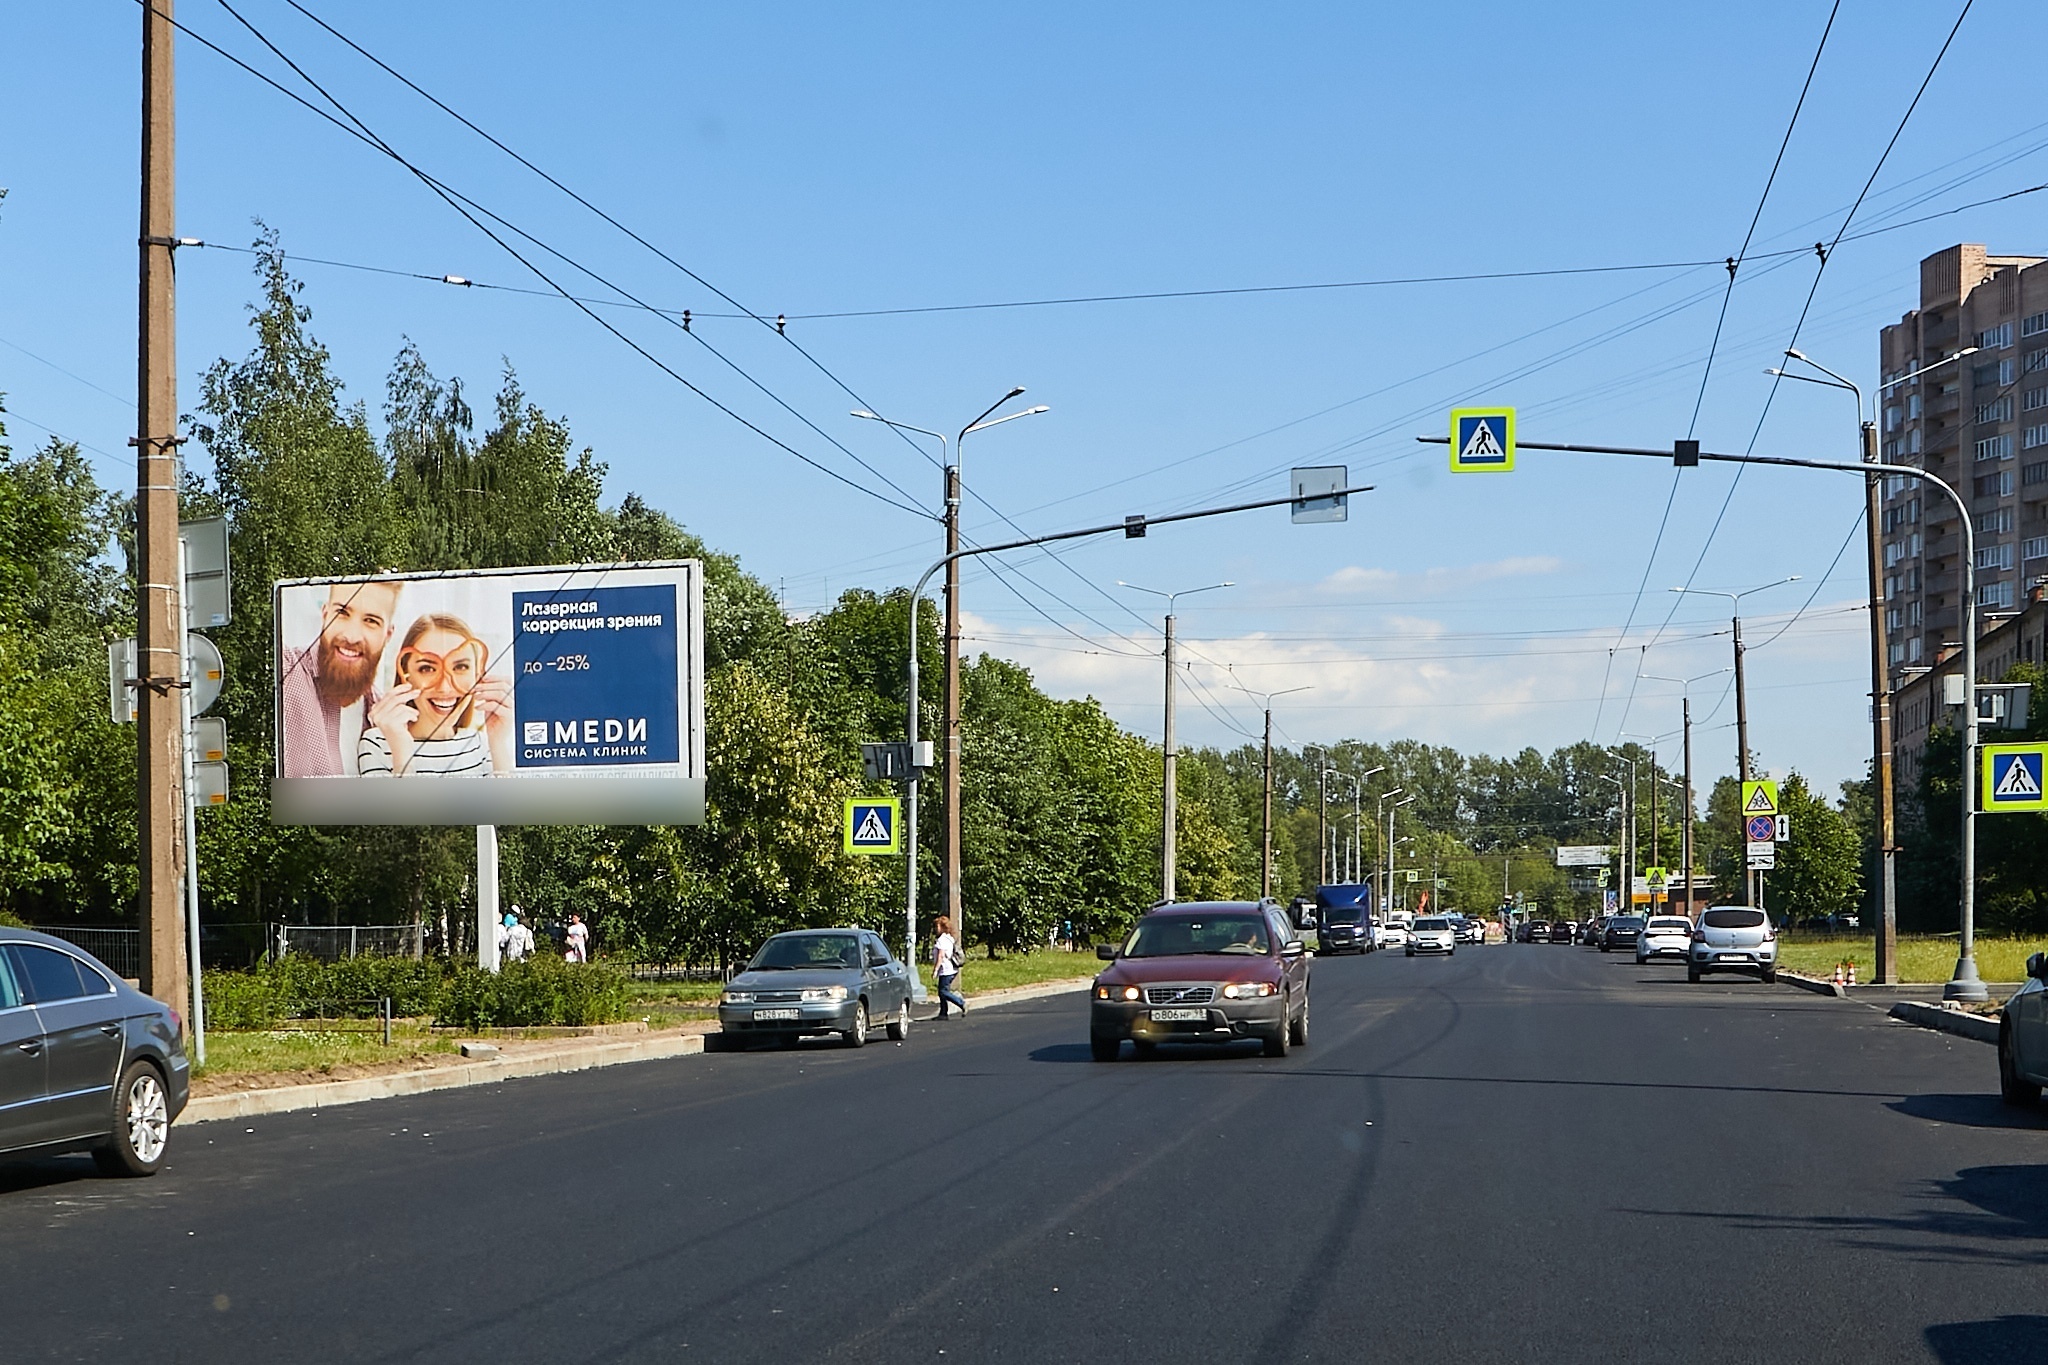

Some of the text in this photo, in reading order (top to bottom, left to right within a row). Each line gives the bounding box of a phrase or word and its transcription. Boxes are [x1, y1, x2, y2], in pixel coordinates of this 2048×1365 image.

[522, 602, 598, 617] Лазерная
[523, 615, 662, 634] коррекция зрения
[524, 662, 543, 674] до
[524, 745, 647, 759] СИСТЕМА КЛИНИК
